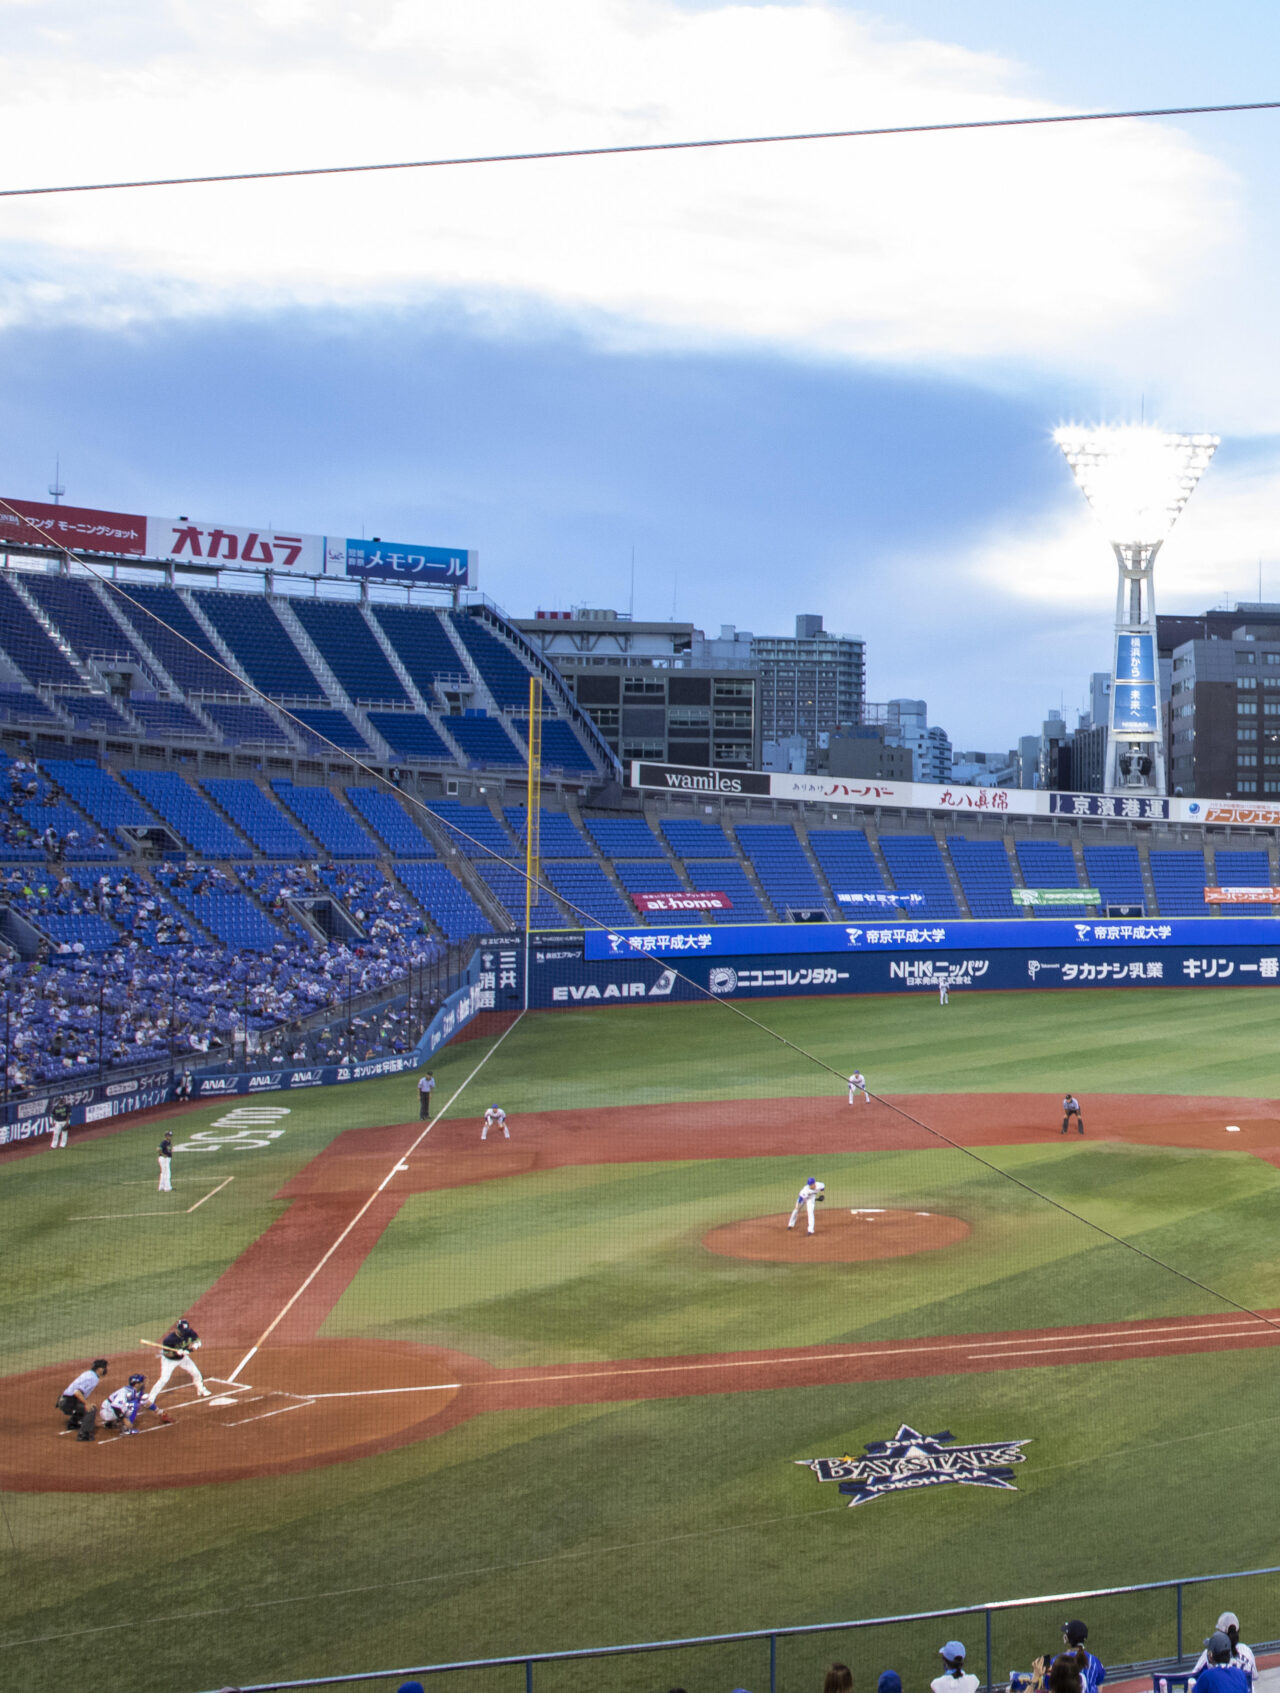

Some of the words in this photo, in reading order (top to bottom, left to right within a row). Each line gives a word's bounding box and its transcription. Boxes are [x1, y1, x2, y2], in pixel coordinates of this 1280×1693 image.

[58, 520, 139, 540] モーニングショット
[171, 526, 303, 565] オカムラ
[365, 550, 467, 577] メモワール
[665, 771, 742, 793] wamiles
[824, 784, 894, 798] ハーバー
[670, 897, 723, 909] home
[628, 933, 712, 951] 帝京平成大学
[866, 928, 946, 943] 帝京平成大学
[1094, 925, 1172, 940] 帝京平成大学
[737, 967, 850, 988] ニコニコレンタカー
[1061, 961, 1164, 981] タカナシ乳業
[1183, 957, 1235, 979] キリン
[552, 984, 602, 1001] EVA
[603, 982, 646, 999] AIR
[201, 1079, 226, 1090] ANA
[248, 1075, 271, 1087] ANA
[290, 1071, 312, 1083] ANA
[885, 1436, 939, 1449] DeNA
[811, 1447, 1028, 1483] BAYSTARS
[866, 1469, 988, 1492] YOKOHAMA
